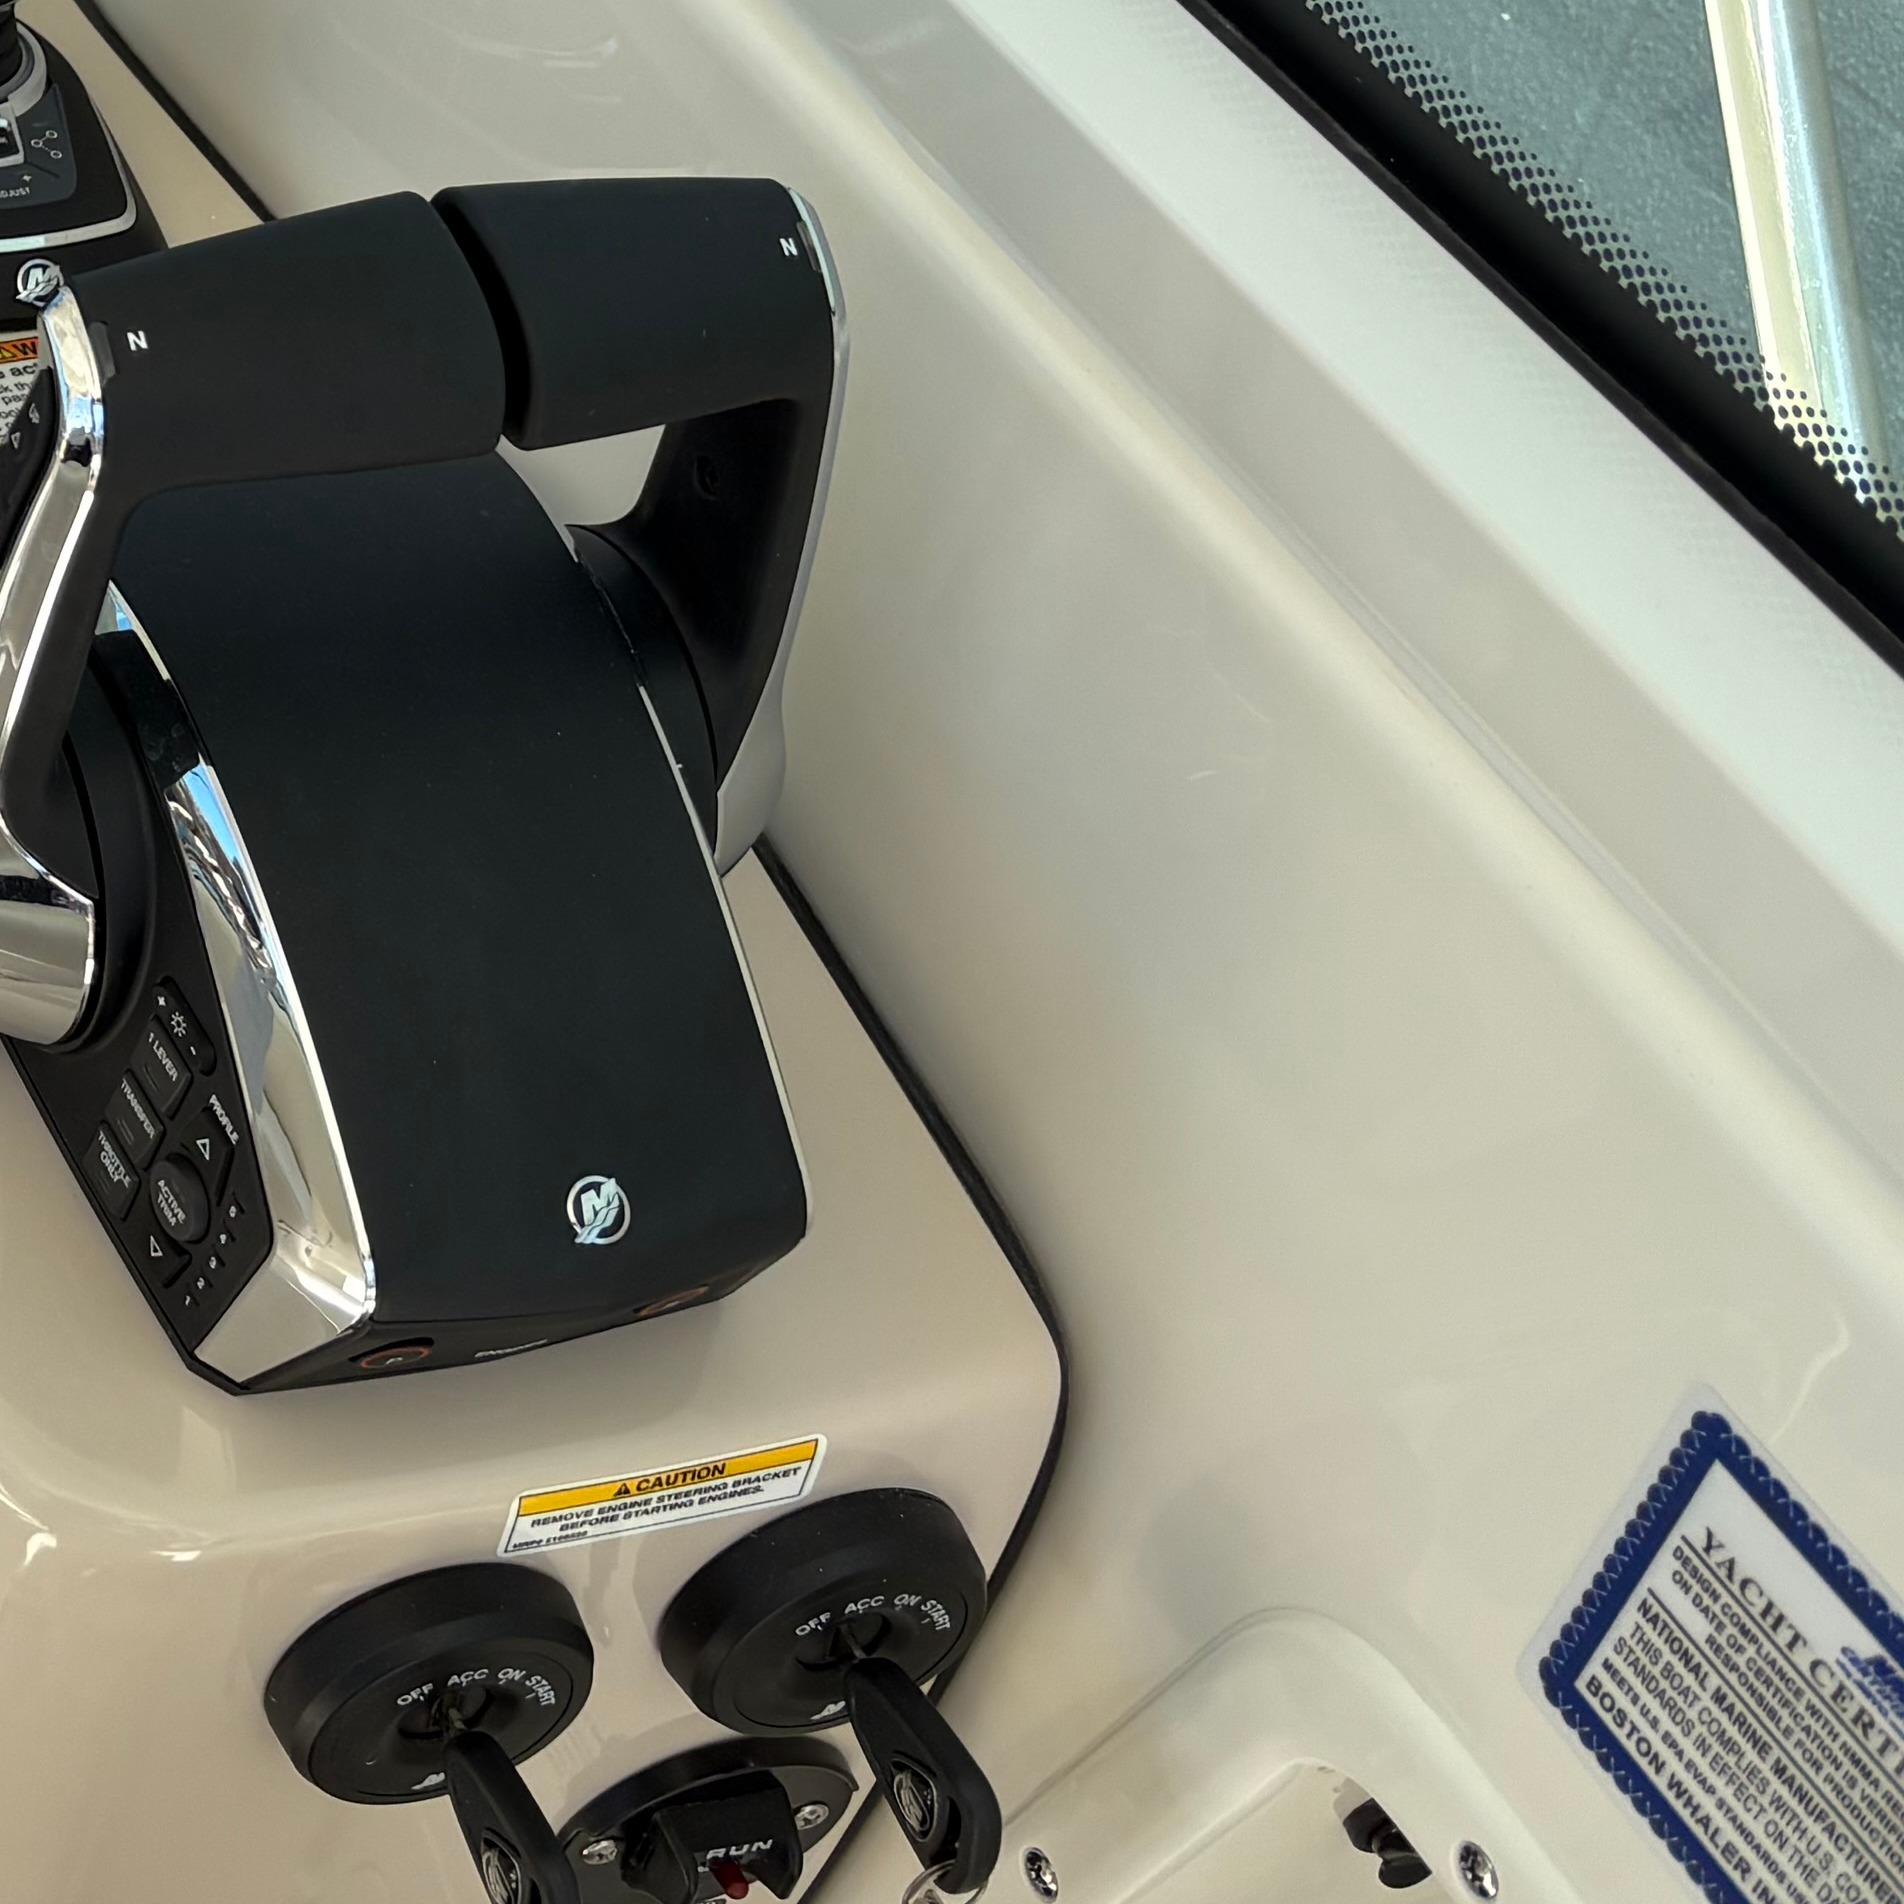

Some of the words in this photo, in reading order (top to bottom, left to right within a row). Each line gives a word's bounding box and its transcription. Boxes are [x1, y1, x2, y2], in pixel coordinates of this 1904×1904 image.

[779, 237, 798, 256] N
[126, 330, 148, 351] N
[153, 1042, 180, 1082] LEVER
[120, 1079, 156, 1140] TRANSFER
[209, 1094, 240, 1146] PROFILE
[156, 1179, 187, 1225] ACTIVE
[156, 1194, 177, 1227] TRIM
[531, 1508, 593, 1528] REMOVE
[597, 1497, 653, 1518] ENGINE
[656, 1482, 728, 1504] STEERING
[732, 1466, 802, 1488] BRACKET
[636, 1462, 726, 1493] CAUTION
[559, 1515, 619, 1532] BEFORE
[622, 1500, 693, 1522] STARTING
[698, 1484, 765, 1507] ENGINES.
[795, 1612, 831, 1636] OFF
[844, 1596, 885, 1614] ACC
[894, 1594, 922, 1607] ON
[920, 1599, 951, 1630] START
[1695, 1526, 1809, 1660] YACHT
[396, 1683, 433, 1706] OFF
[447, 1668, 489, 1686] ACC
[497, 1668, 526, 1681] ON
[525, 1675, 556, 1706] START
[1600, 1655, 1641, 1707] MEETS
[1635, 1596, 1714, 1692] NATIONAL
[1709, 1684, 1773, 1762] MARINE
[1670, 1543, 1722, 1606] DESIGN
[1718, 1599, 1807, 1703] COMPLIANCE
[1802, 1697, 1840, 1744] WITH
[1837, 1738, 1883, 1793] NMMA
[1690, 1591, 1727, 1636] DATE
[1743, 1654, 1844, 1773] CERTIFICATION
[1703, 1632, 1795, 1742] RESPONSIBLE
[1792, 1736, 1824, 1777] FOR
[1627, 1620, 1664, 1668] THIS
[1658, 1658, 1702, 1713] BOAT
[1695, 1702, 1772, 1797] COMPLIES
[1766, 1787, 1809, 1842] WITH
[1584, 1672, 1666, 1778] BOSTON
[1664, 1770, 1752, 1884] WHALER
[1612, 1634, 1696, 1740] STANDARDS
[1708, 1750, 1767, 1826] EFFECT
[1785, 1844, 1820, 1890] THE
[706, 1839, 773, 1859] RUN
